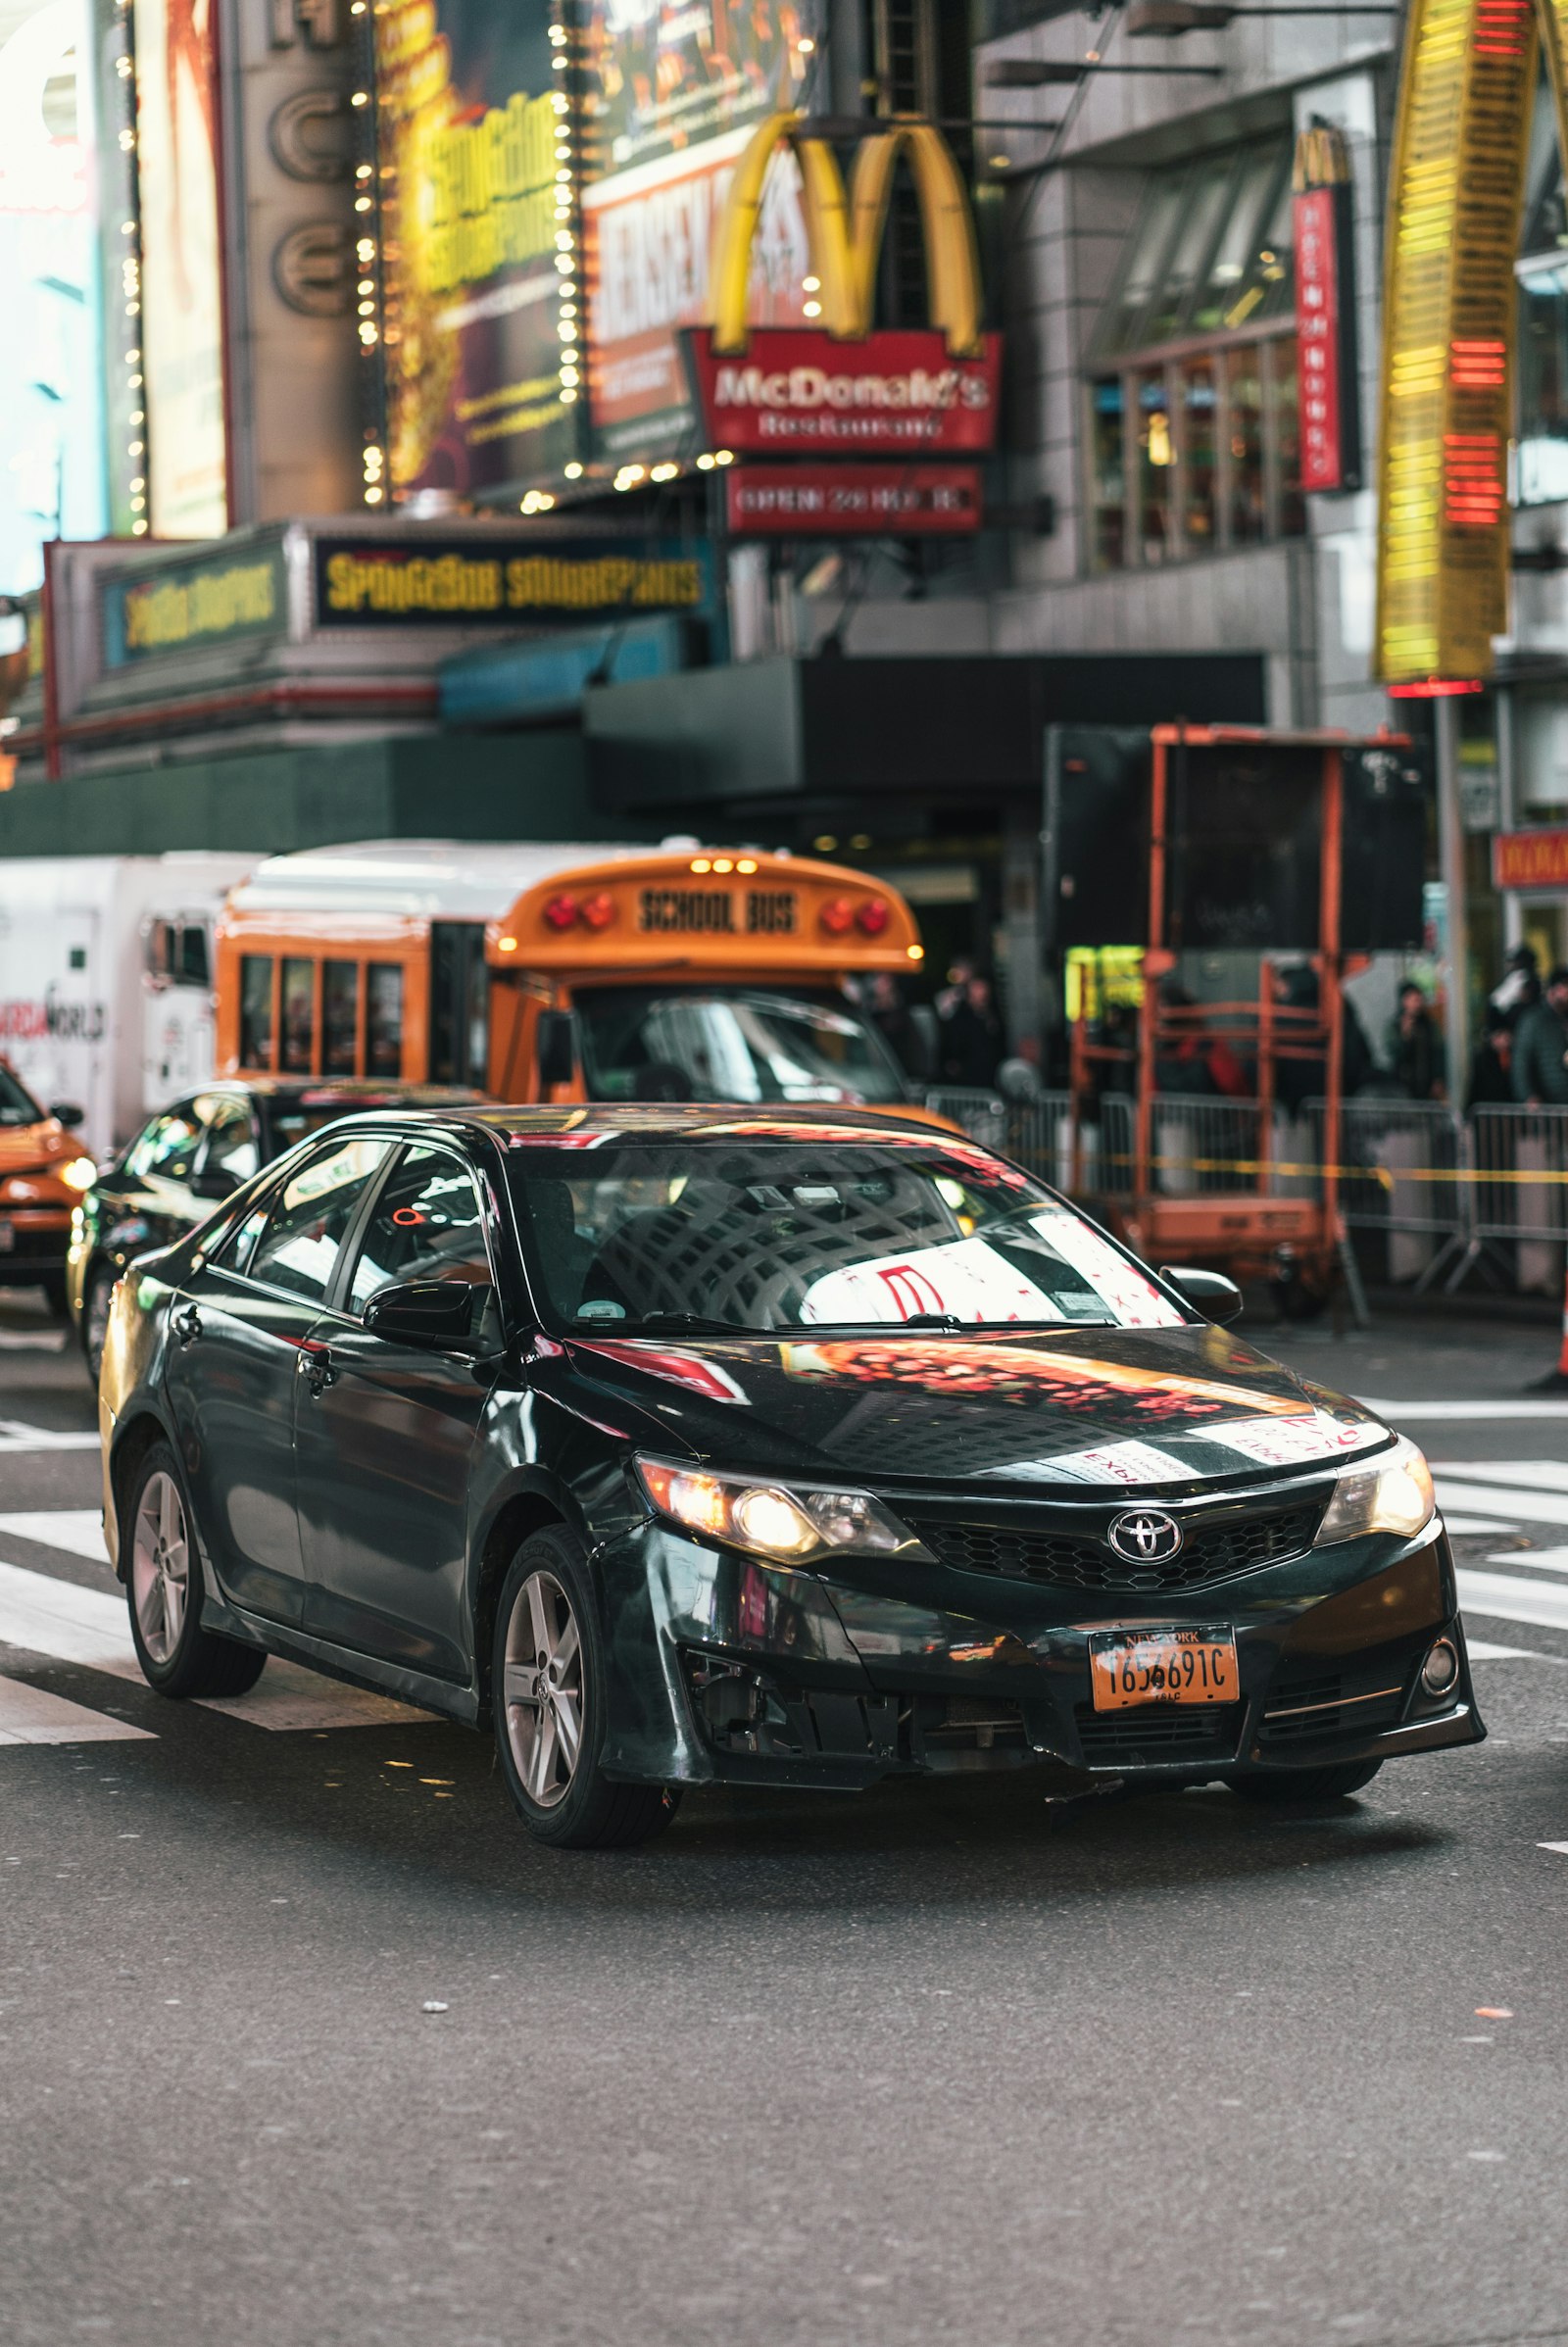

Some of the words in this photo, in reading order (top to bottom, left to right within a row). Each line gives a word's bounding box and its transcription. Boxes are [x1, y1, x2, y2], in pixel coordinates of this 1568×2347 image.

[714, 367, 989, 409] McDonald's
[642, 889, 734, 932] SCHOOL
[747, 890, 797, 934] BUS
[1126, 1633, 1158, 1648] NEW
[1165, 1631, 1200, 1644] YORK
